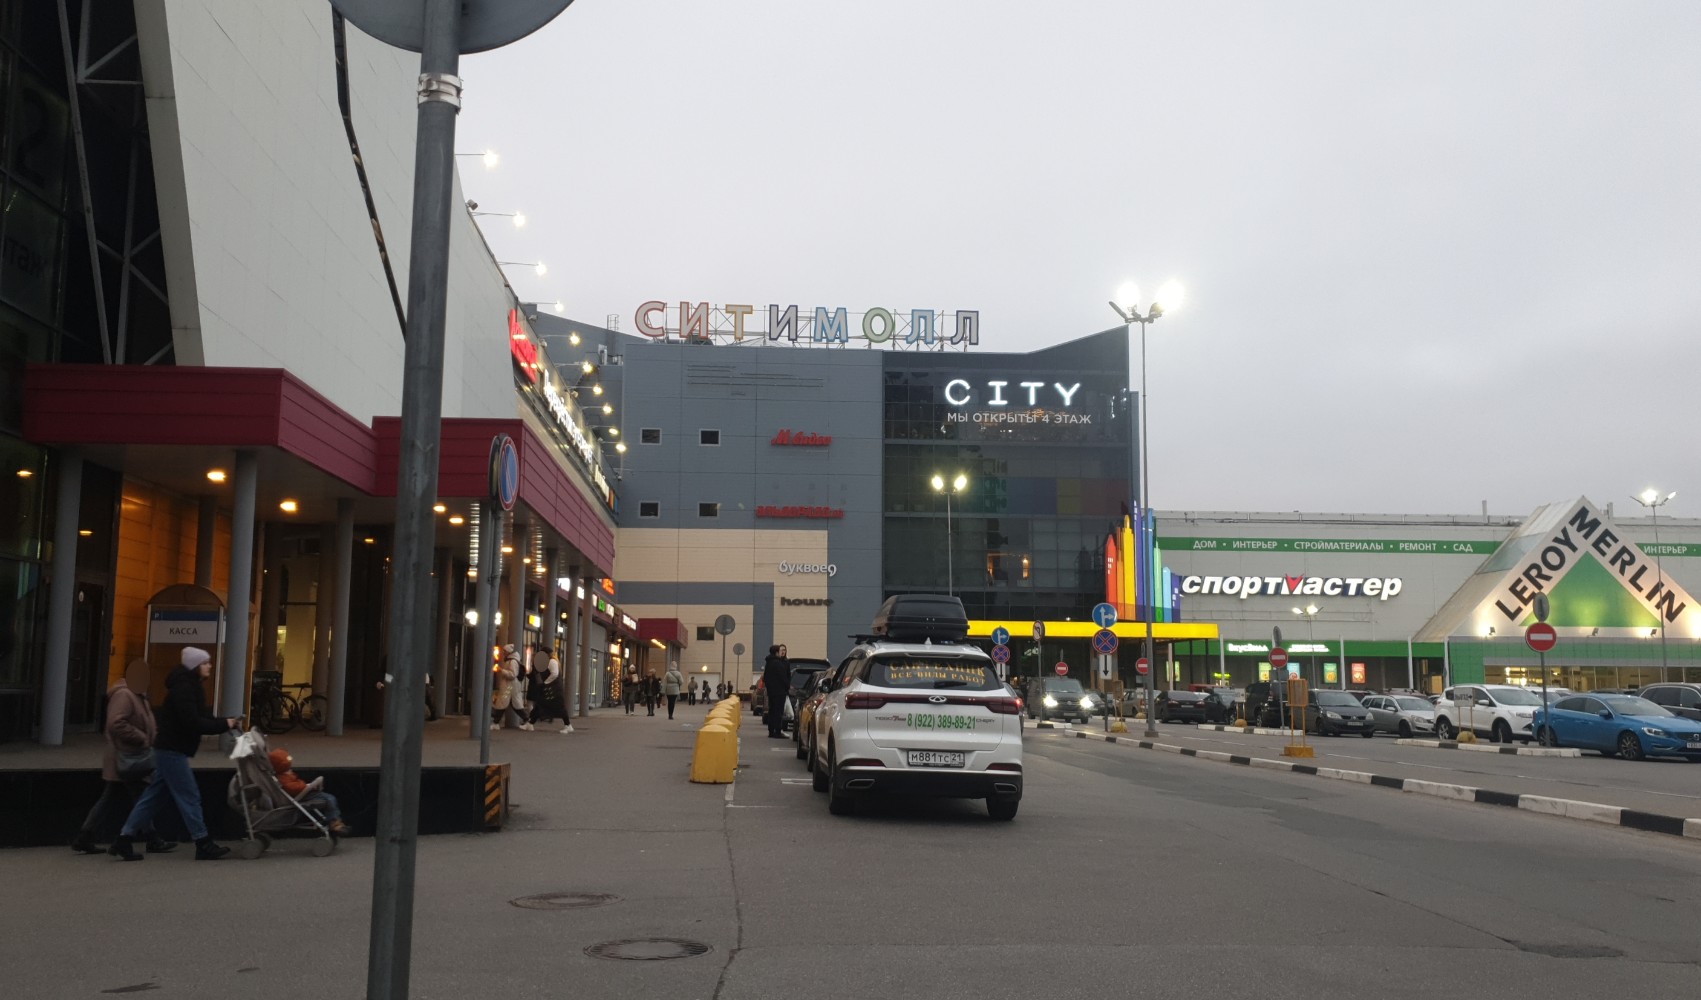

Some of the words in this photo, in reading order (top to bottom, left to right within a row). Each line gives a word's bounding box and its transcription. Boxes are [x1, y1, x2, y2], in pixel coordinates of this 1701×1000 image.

[634, 301, 980, 346] СИТИМОЛЛ
[944, 379, 1081, 406] CITY
[947, 412, 968, 423] МЫ
[972, 413, 1037, 424] ОТКРЫТЫ
[1041, 414, 1050, 424] 4
[1054, 414, 1092, 425] ЭТАЖ
[1193, 540, 1217, 550] ДОМ
[1232, 540, 1278, 550] ИНТЕРЬЕР
[1294, 540, 1384, 551] СТРОЙМАТЕРИАЛЫ
[1399, 542, 1437, 552] РЕМОНТ
[1453, 543, 1474, 553] САД
[1643, 545, 1688, 554] ИНТЕРЬЕР
[1495, 526, 1579, 622] LEROY
[1568, 505, 1687, 623] MERLIN
[169, 627, 198, 636] КАССА
[952, 673, 985, 685] РАБОТ
[907, 713, 912, 727] 8
[915, 714, 935, 730] (922)
[937, 714, 976, 729] 389-89-21
